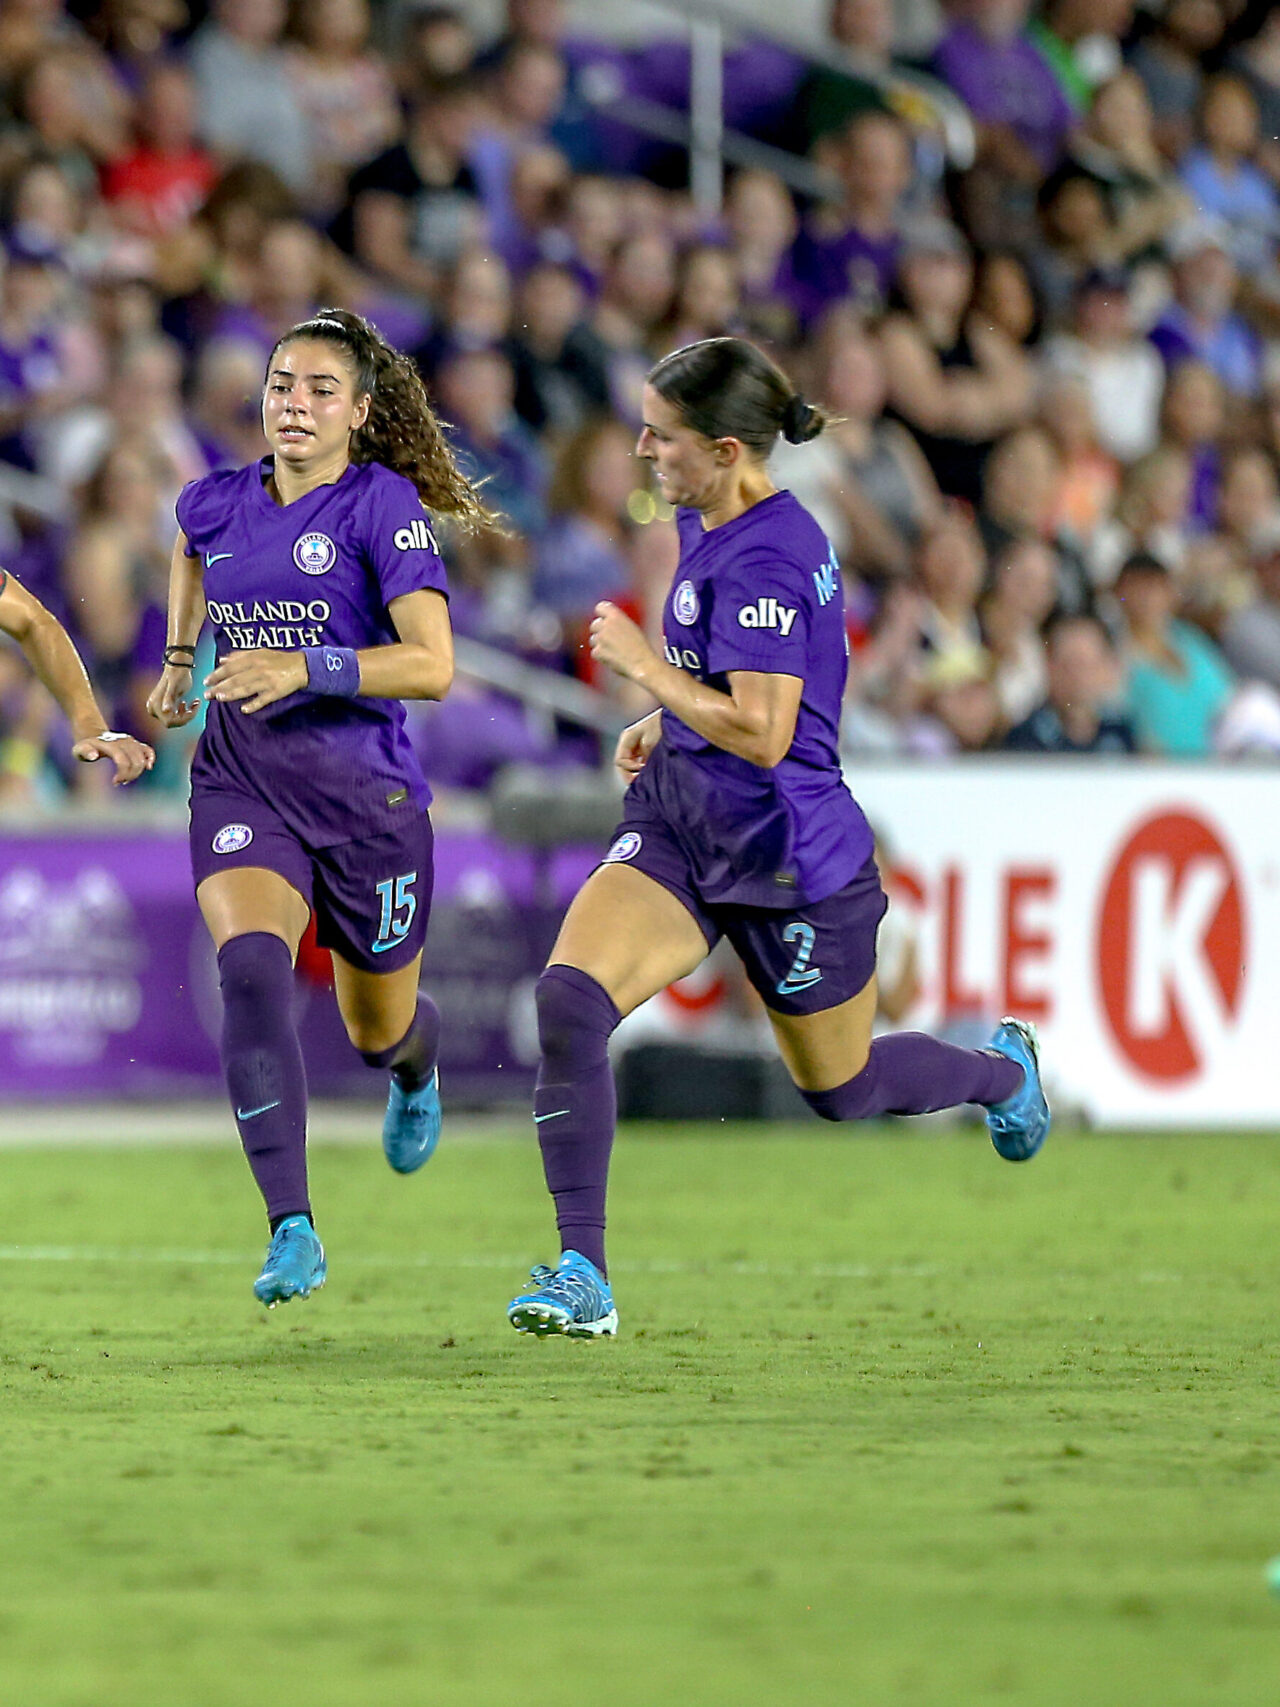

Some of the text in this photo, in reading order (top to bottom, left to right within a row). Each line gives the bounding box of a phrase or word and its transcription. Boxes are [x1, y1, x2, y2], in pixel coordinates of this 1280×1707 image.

[207, 600, 330, 624] ORLANDO
[737, 597, 798, 636] ally
[376, 871, 418, 940] 15
[782, 922, 821, 982] 2
[1122, 852, 1242, 1076] K
